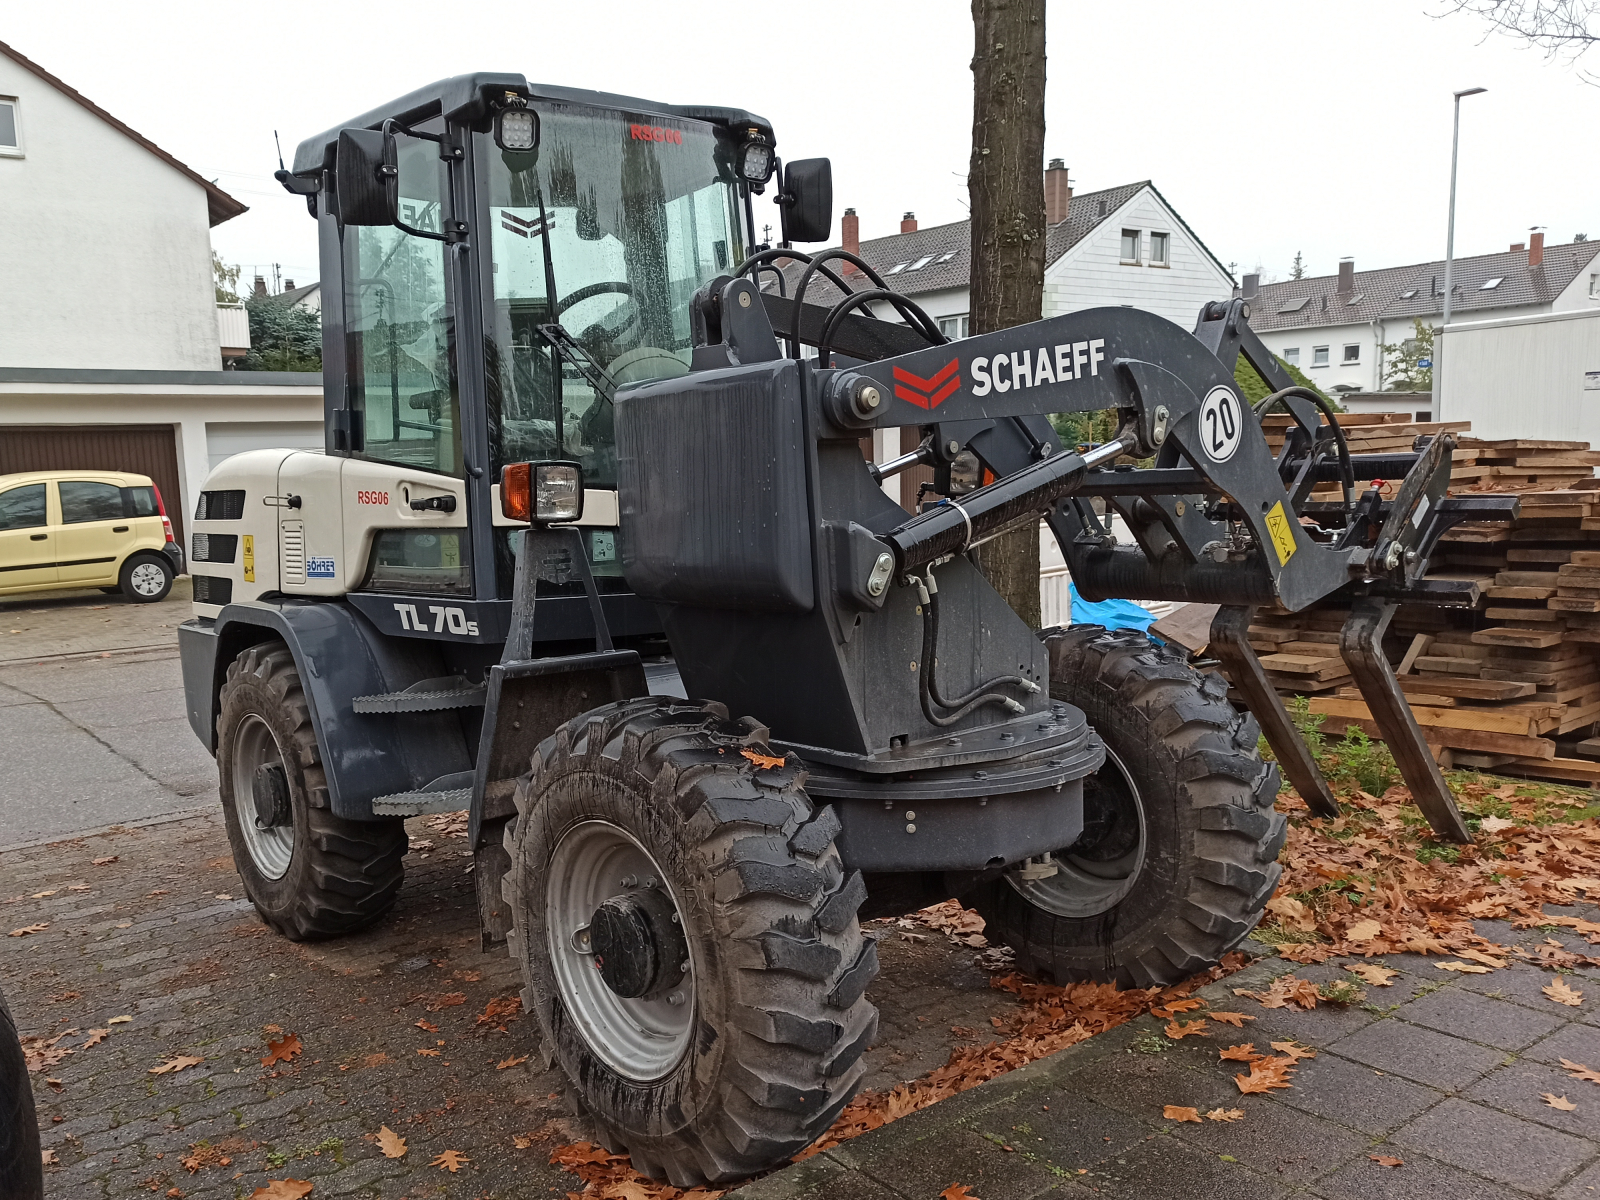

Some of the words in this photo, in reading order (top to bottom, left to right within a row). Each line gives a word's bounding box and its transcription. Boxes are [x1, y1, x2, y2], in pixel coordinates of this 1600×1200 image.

[630, 124, 683, 146] RSG06
[970, 338, 1105, 397] SCHAEFF
[1205, 397, 1236, 454] 20
[357, 490, 389, 506] RSG06
[393, 603, 429, 632] TL
